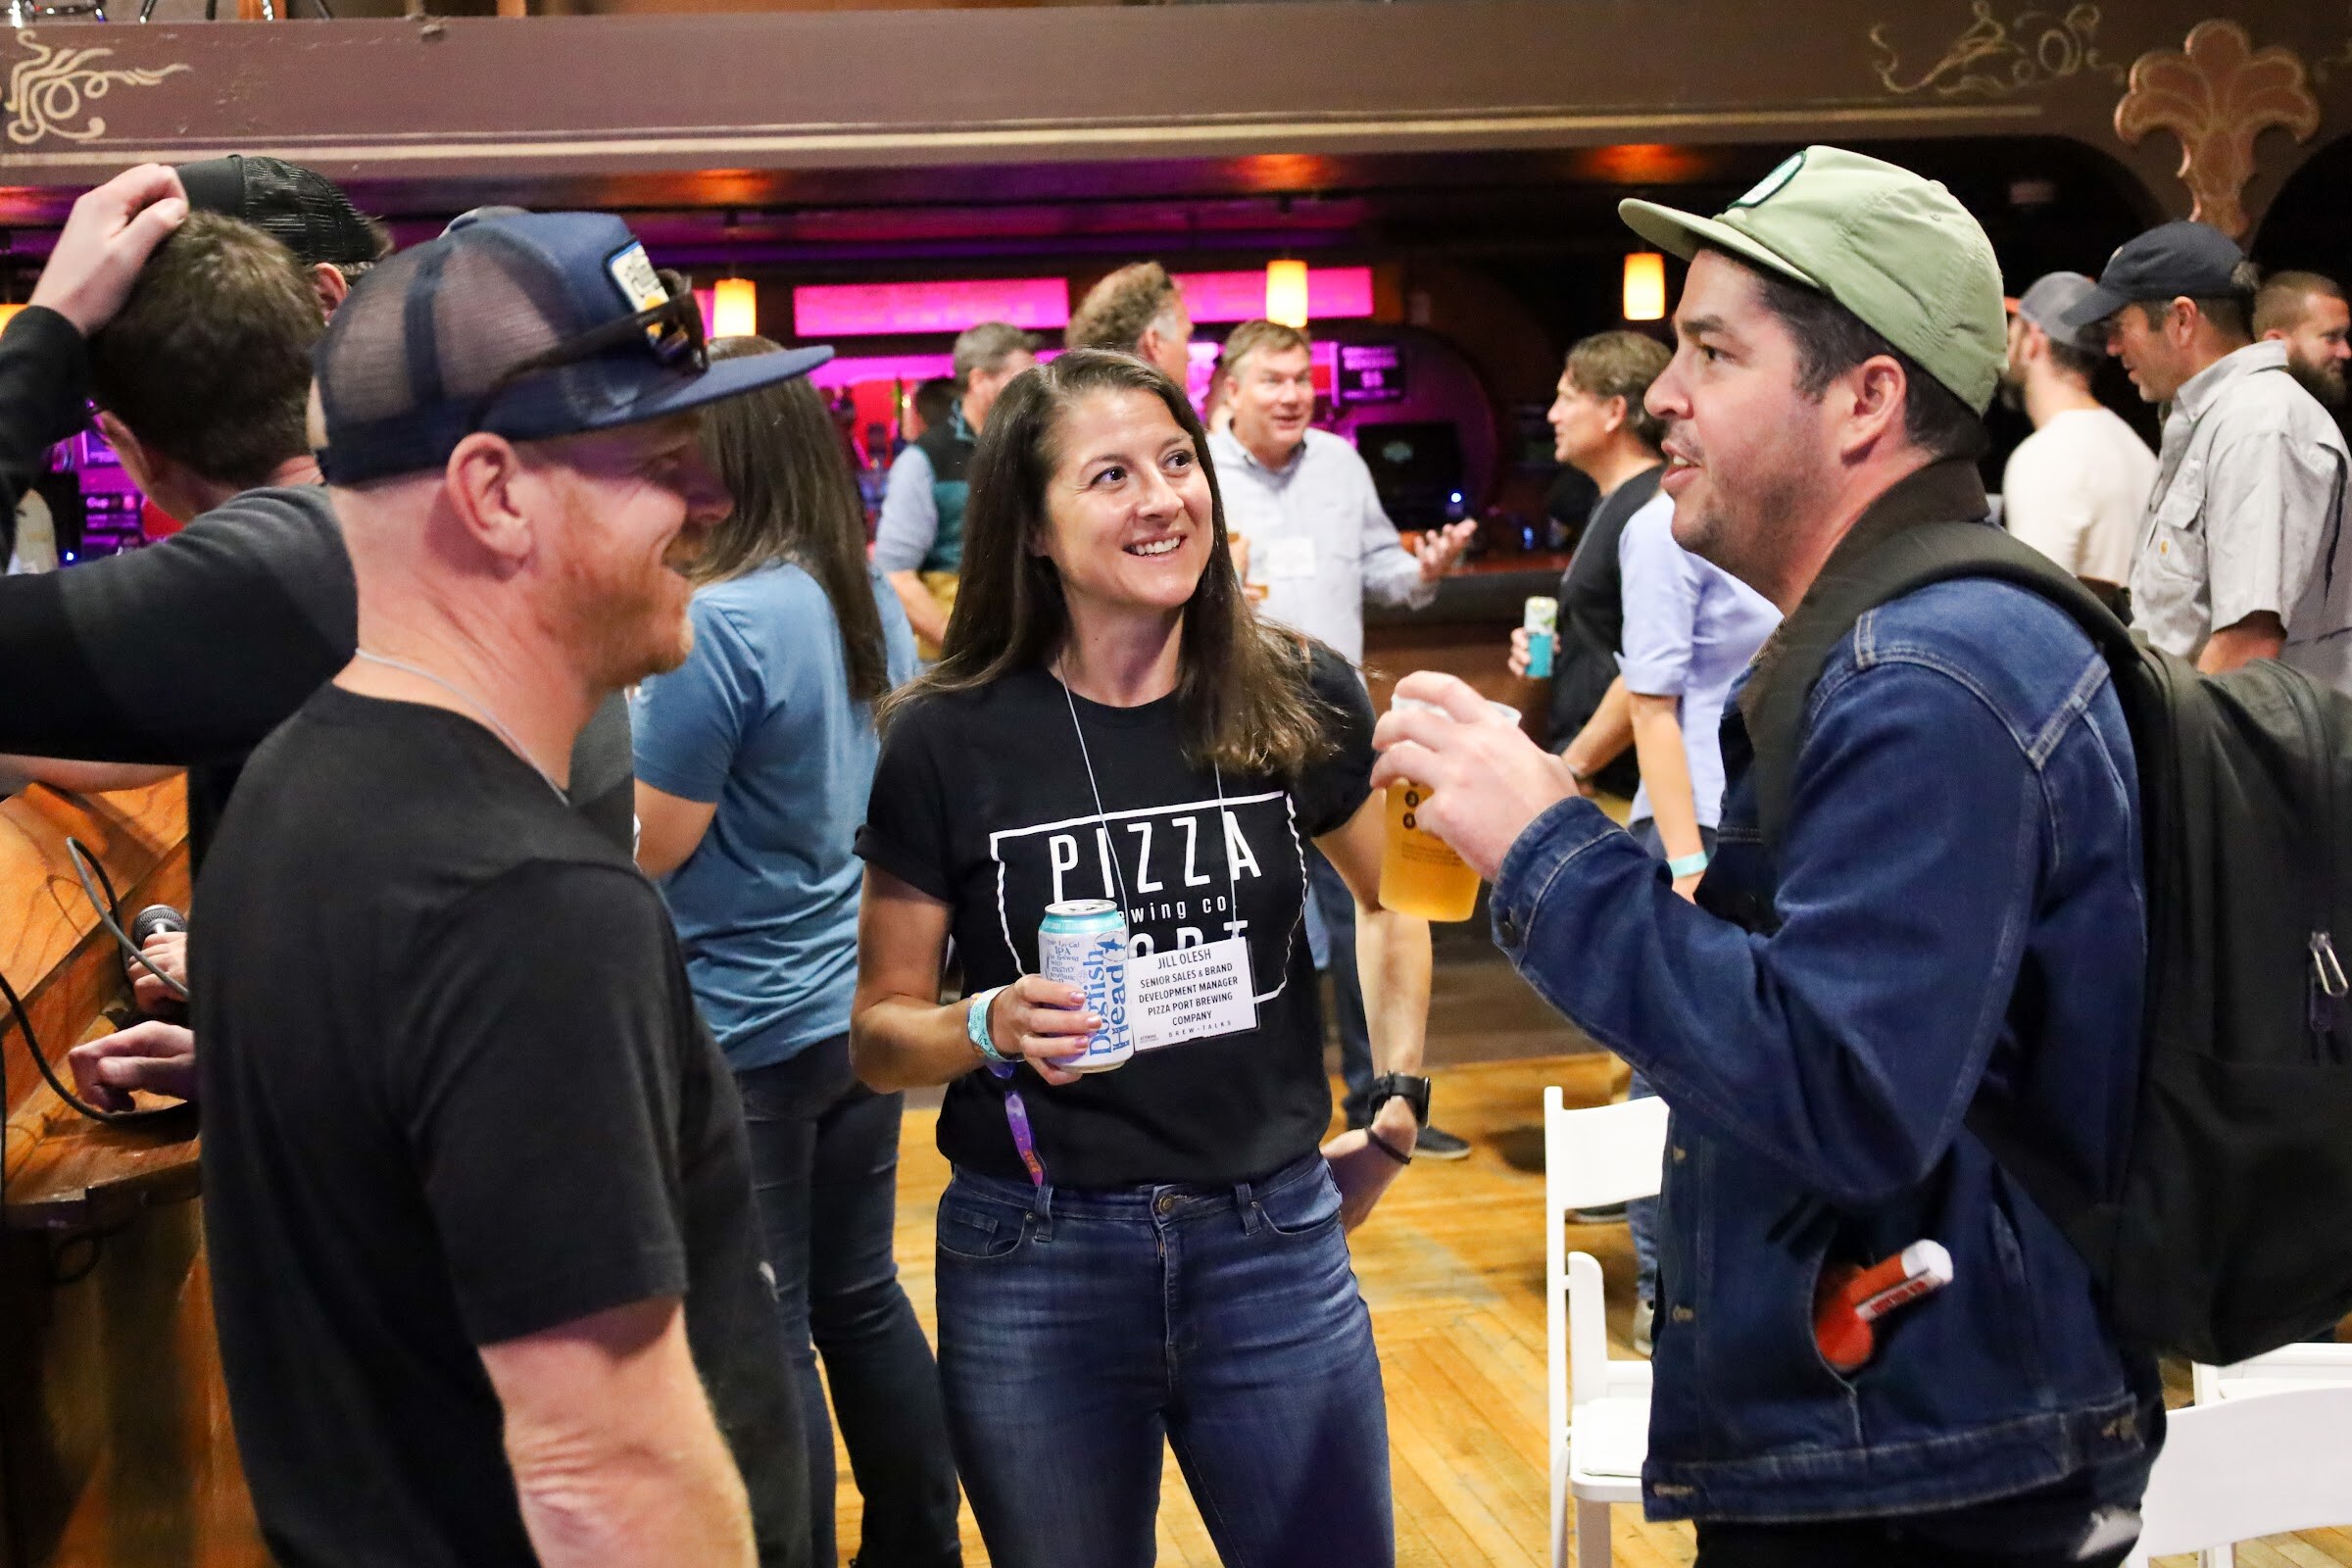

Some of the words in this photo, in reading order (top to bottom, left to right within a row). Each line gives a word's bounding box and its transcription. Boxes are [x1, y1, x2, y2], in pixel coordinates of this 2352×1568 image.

[1049, 810, 1262, 903] PIZZA
[1054, 945, 1071, 956] IPA
[1157, 955, 1178, 970] JILL
[1179, 948, 1212, 965] OLESH
[1140, 974, 1170, 989] SENIOR
[1172, 969, 1197, 983] SALES
[1204, 962, 1233, 976] BRAND
[1139, 984, 1198, 1004] DEVELOPMENT
[1199, 976, 1239, 992] MANAGER
[1105, 963, 1130, 1052] Head
[1148, 1004, 1171, 1016] PIZZA
[1172, 999, 1194, 1011] PORT
[1196, 992, 1233, 1007] BREWING
[1172, 1010, 1212, 1026] COMPANY
